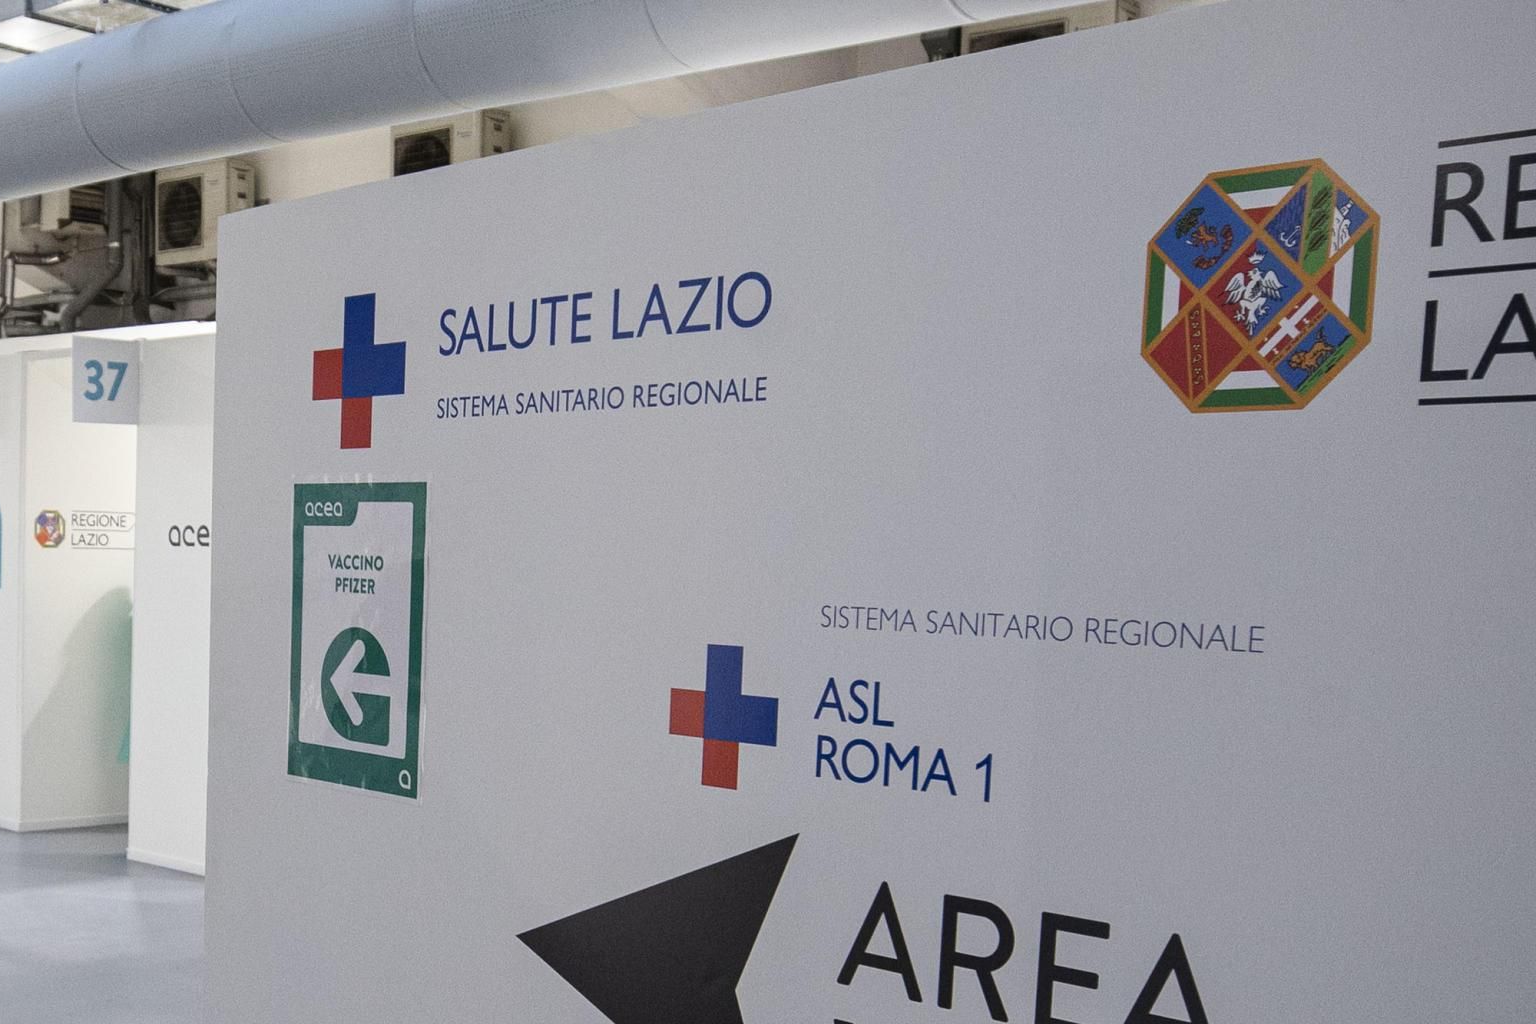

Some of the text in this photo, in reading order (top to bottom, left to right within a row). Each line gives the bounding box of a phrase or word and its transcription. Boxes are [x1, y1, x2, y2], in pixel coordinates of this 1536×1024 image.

[438, 270, 773, 357] SALUTE LAZIO
[83, 359, 129, 402] 37
[436, 376, 768, 420] SISTEMA SANITARIO REGIONALE
[71, 512, 127, 528] REGIONE
[305, 501, 343, 517] acea
[71, 533, 110, 547] LAZIO
[327, 553, 385, 572] VACCINO
[335, 577, 376, 595] PFIZER
[819, 604, 1266, 654] SISTEMA SANITARIO REGIONALE
[813, 676, 896, 728] ASL
[814, 734, 994, 803] ROMA 1
